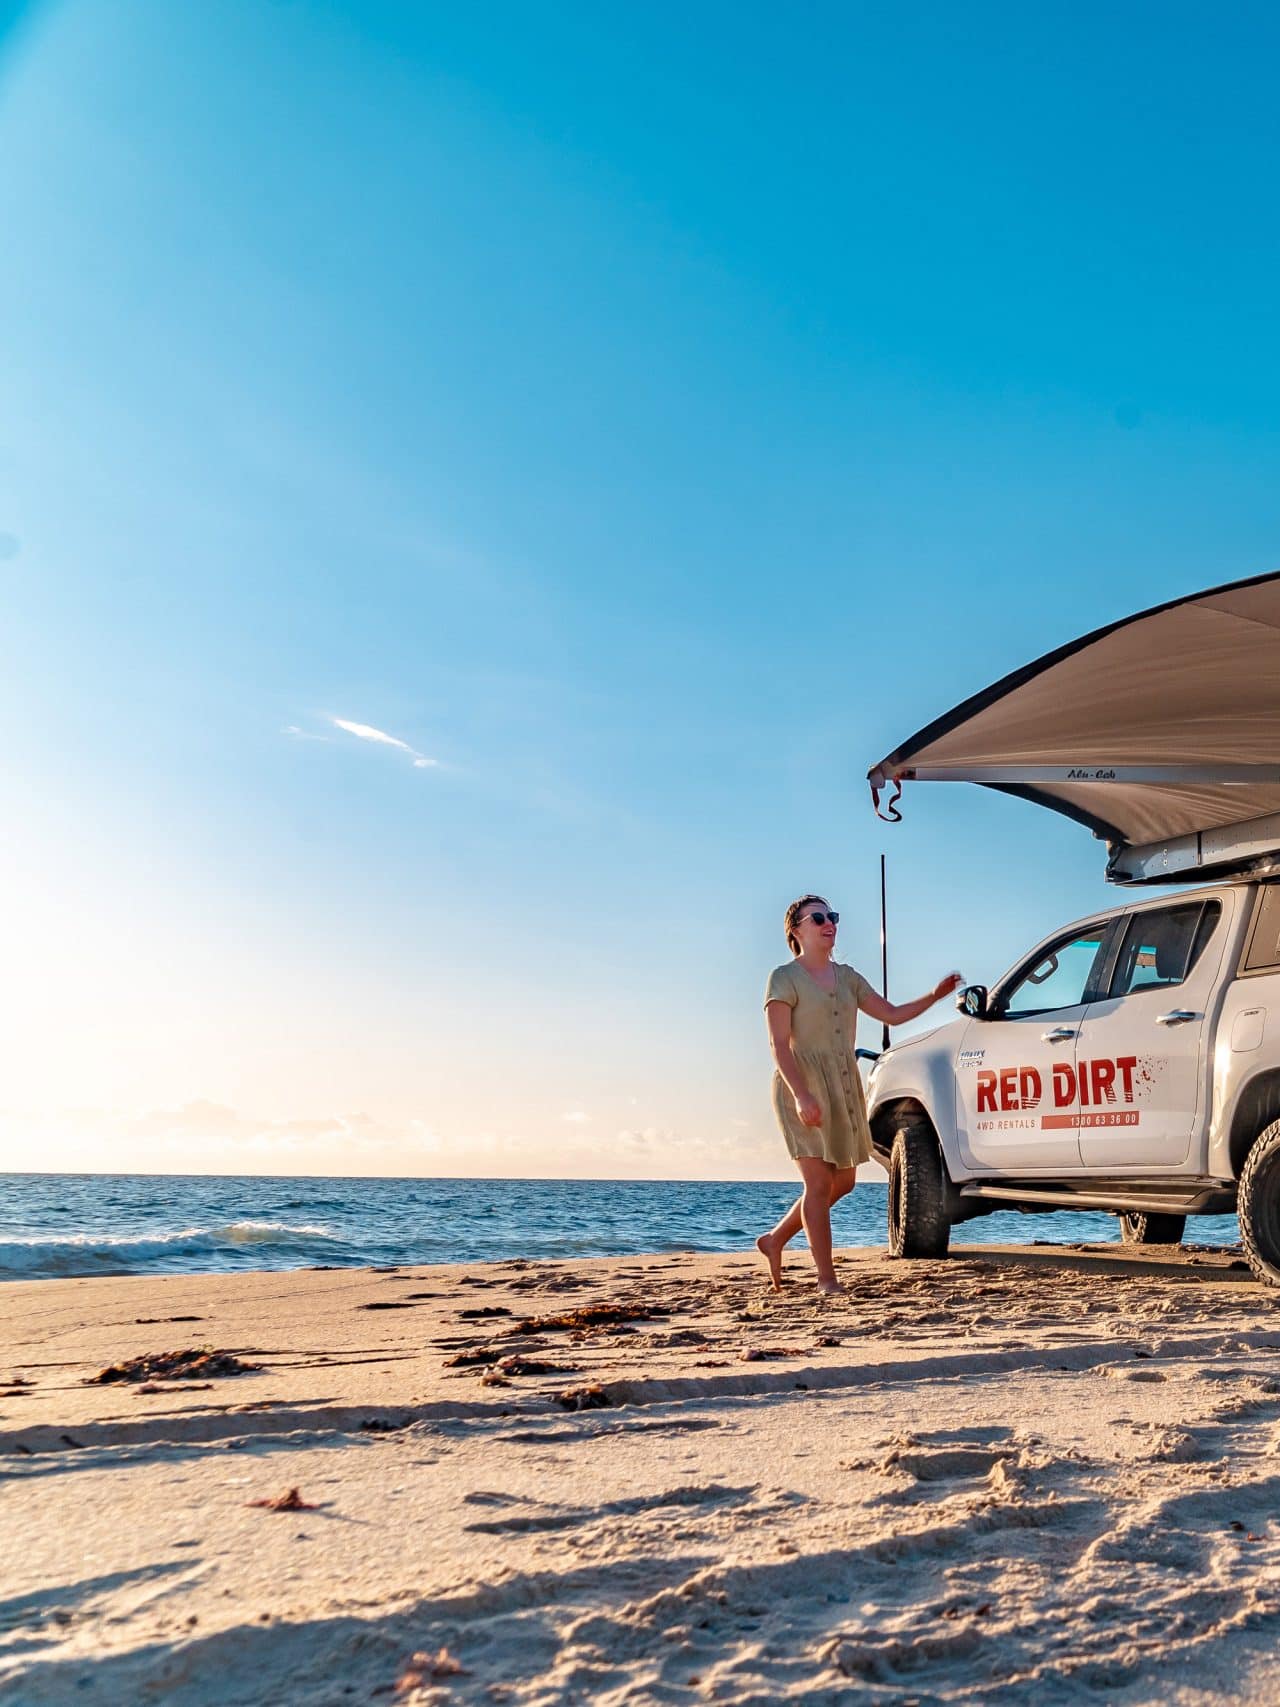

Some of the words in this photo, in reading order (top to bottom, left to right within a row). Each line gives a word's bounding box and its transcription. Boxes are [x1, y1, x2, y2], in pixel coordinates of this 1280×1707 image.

[976, 1065, 1042, 1113] RED
[1052, 1056, 1137, 1108] DIRT
[976, 1120, 994, 1131] 4WD
[998, 1119, 1036, 1130] RENTALS
[1071, 1116, 1091, 1126] 1300
[1095, 1115, 1106, 1125] 63
[1110, 1114, 1121, 1125] 36
[1125, 1113, 1136, 1124] 00
